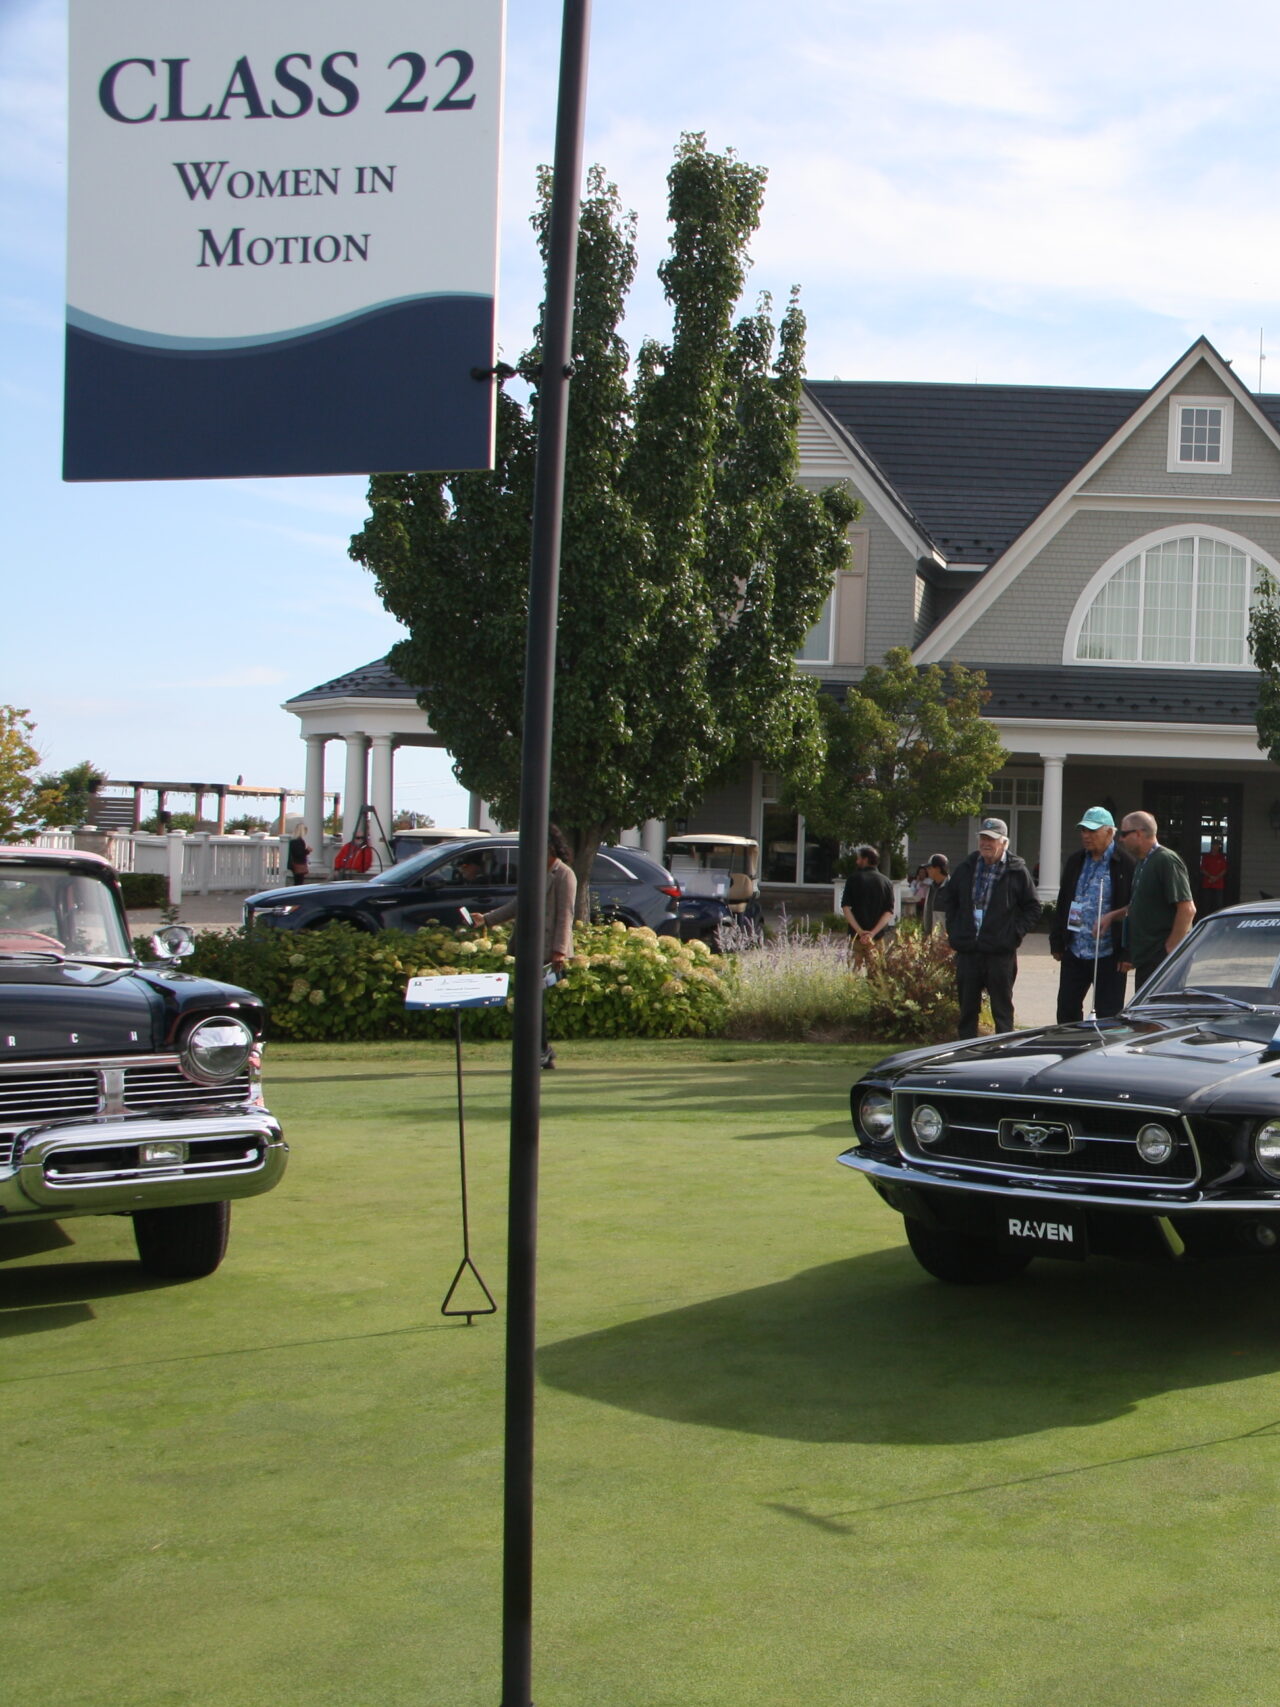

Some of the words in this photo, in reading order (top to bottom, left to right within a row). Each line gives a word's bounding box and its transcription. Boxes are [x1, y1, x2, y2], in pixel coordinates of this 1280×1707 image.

[99, 51, 360, 125] CLASS
[385, 49, 477, 114] 22
[1008, 1218, 1073, 1243] RAVEN
